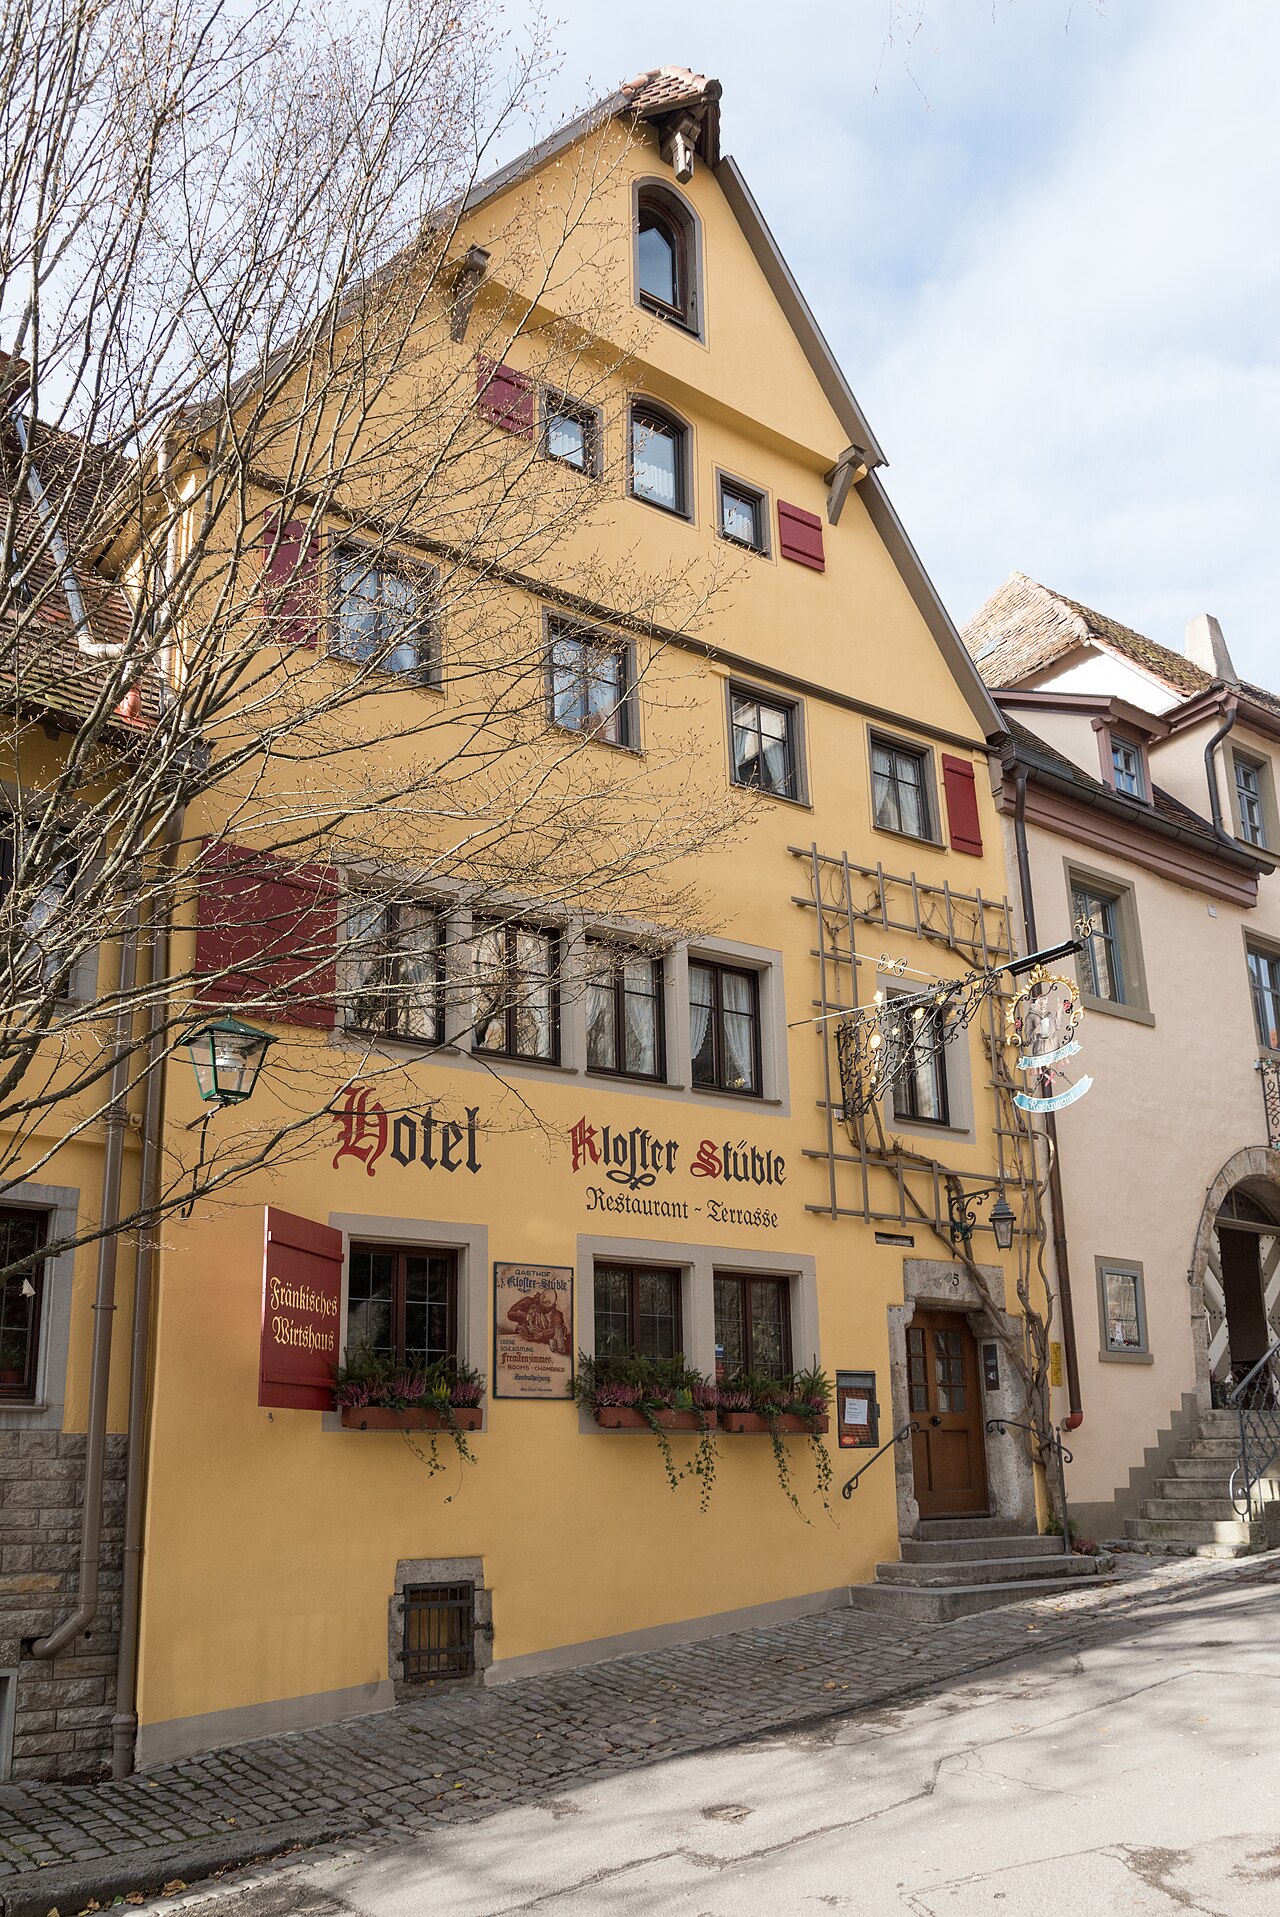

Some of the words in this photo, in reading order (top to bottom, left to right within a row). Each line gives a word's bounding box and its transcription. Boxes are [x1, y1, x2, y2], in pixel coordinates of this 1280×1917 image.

[1026, 1091, 1075, 1111] Restaurant
[332, 1086, 482, 1177] Hotel
[567, 1115, 680, 1190] Kloster
[690, 1139, 787, 1186] Stüble
[586, 1187, 689, 1220] Restaurant
[706, 1199, 779, 1228] Terrasse
[515, 1269, 551, 1277] GASTHOF
[952, 1272, 960, 1287] 5
[269, 1276, 338, 1320] Fränkisches
[271, 1315, 335, 1354] Wirtshaus
